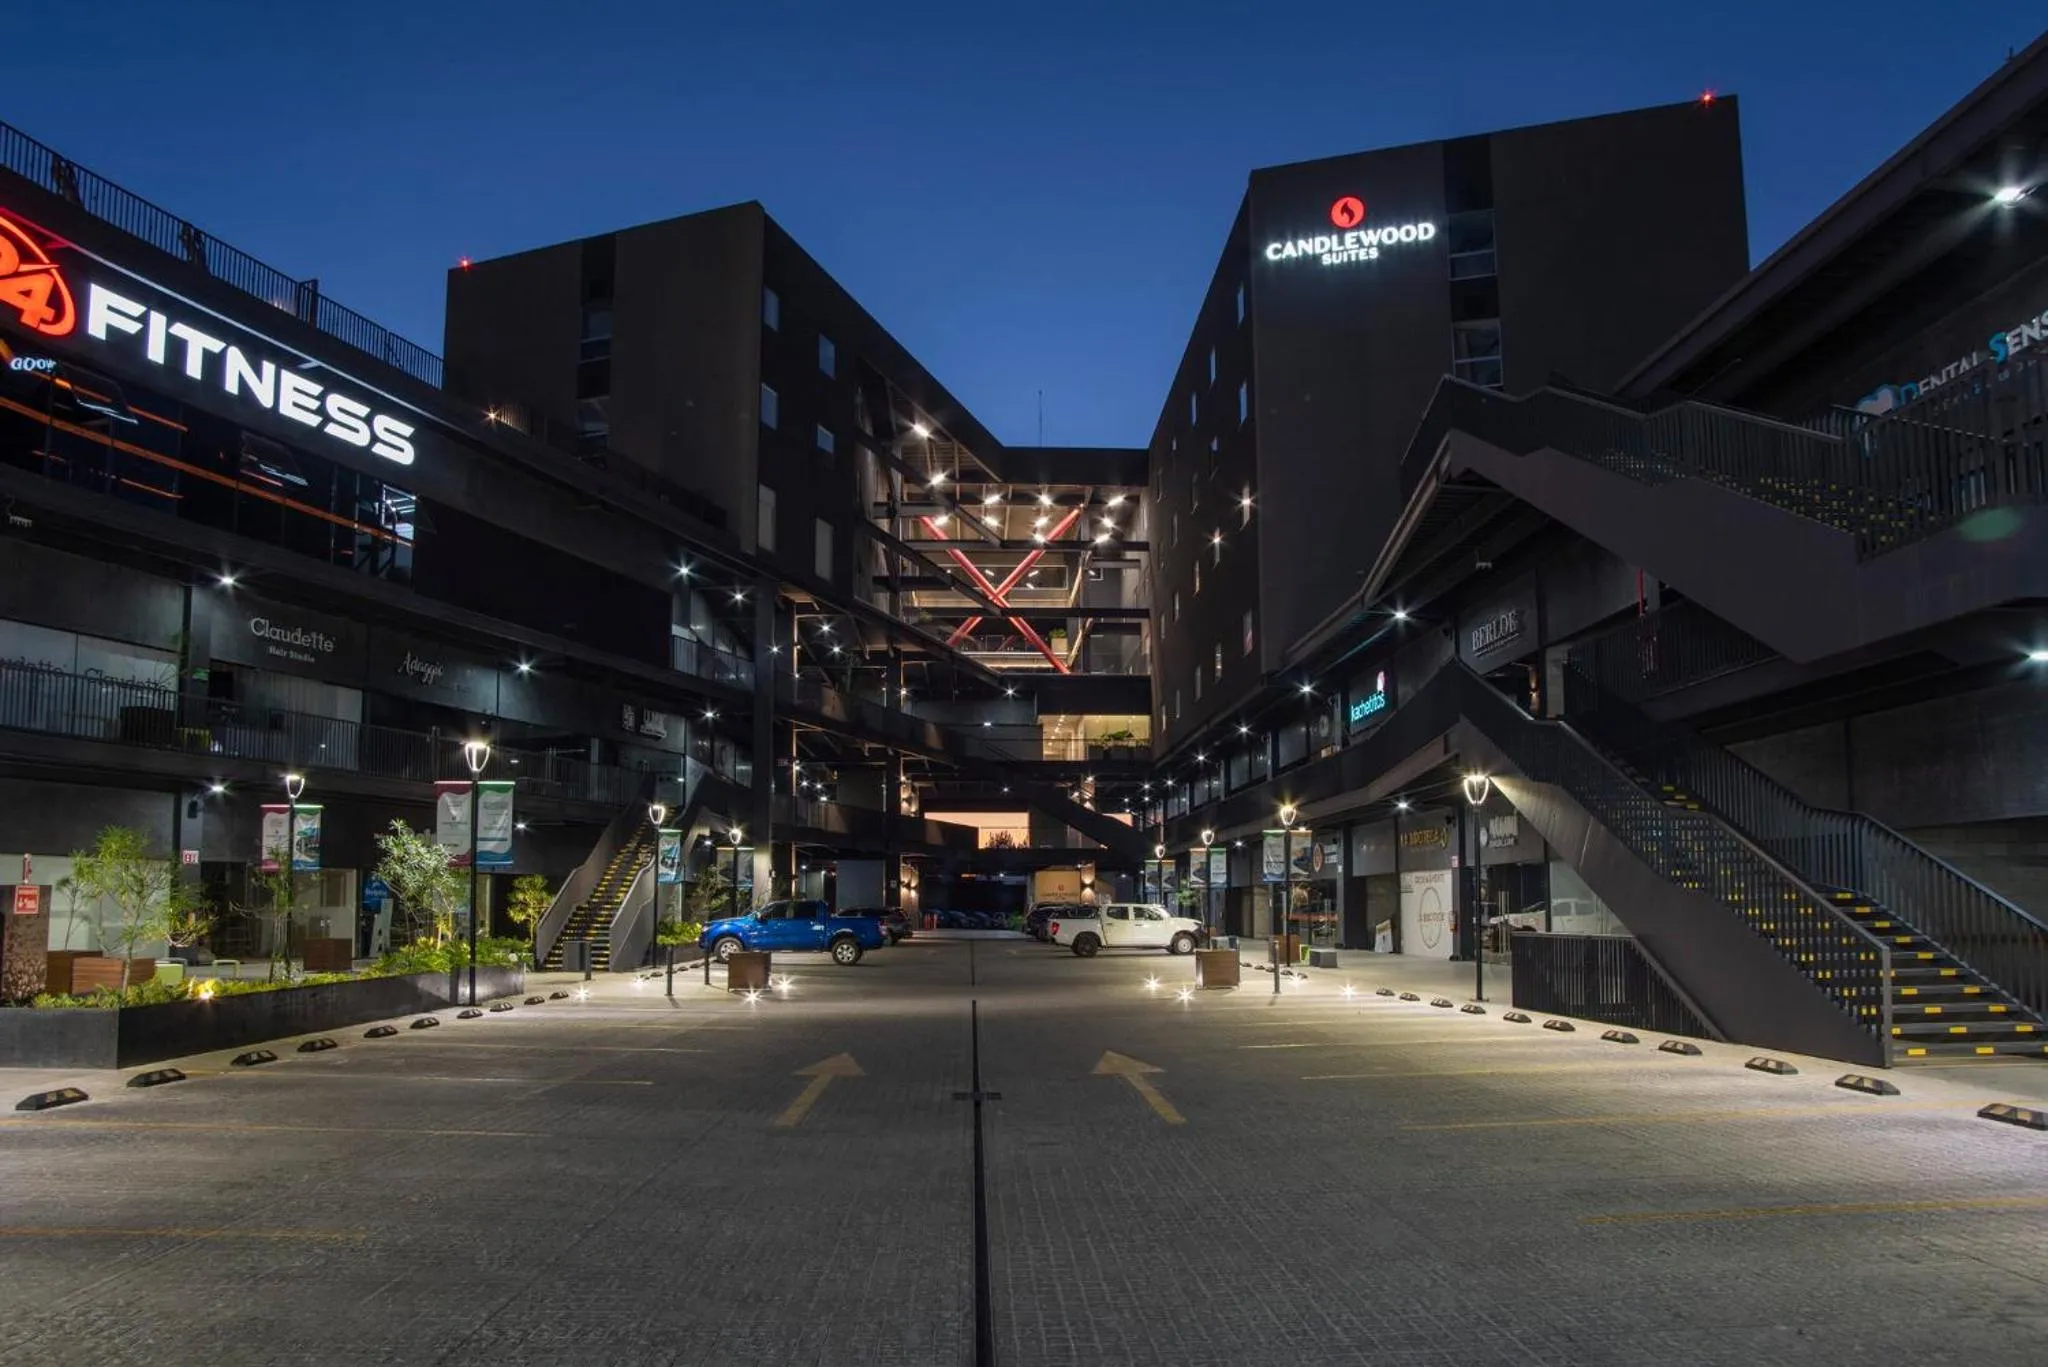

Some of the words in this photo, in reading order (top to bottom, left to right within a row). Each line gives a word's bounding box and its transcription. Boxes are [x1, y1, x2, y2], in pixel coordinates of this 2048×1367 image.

[1265, 222, 1436, 261] CANDLEWOOD
[1322, 246, 1379, 266] SUITES
[88, 283, 416, 466] FITNESS
[250, 617, 334, 653] Claudette
